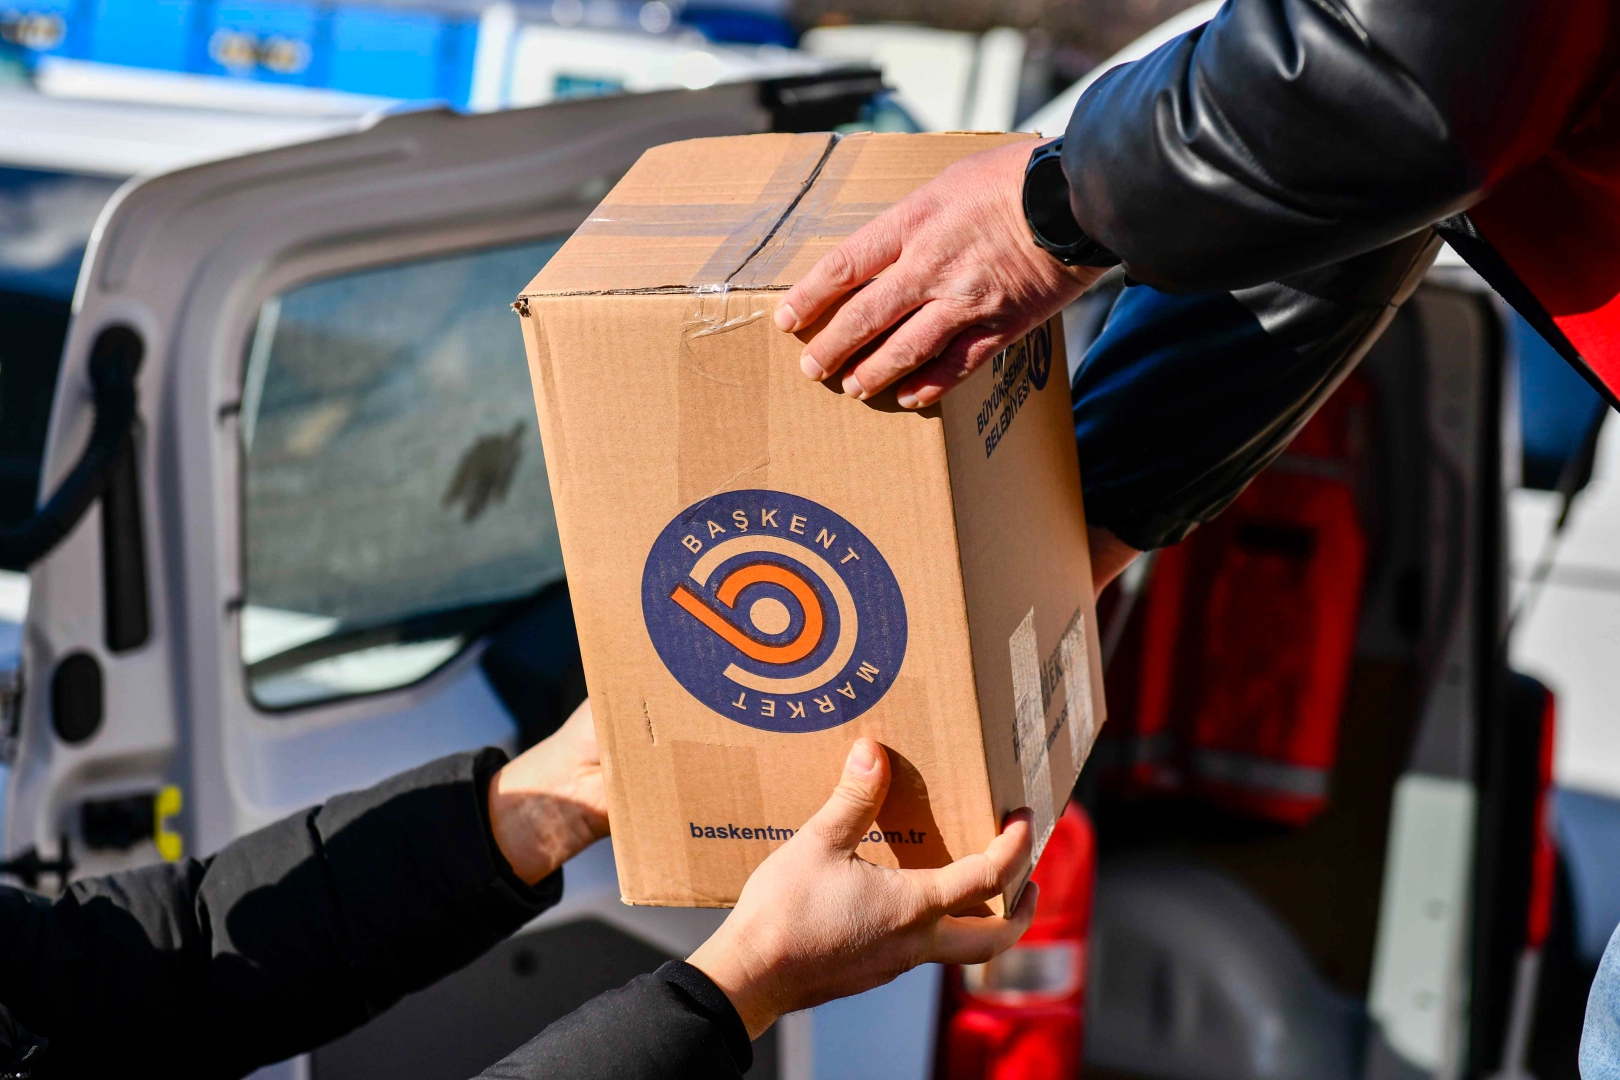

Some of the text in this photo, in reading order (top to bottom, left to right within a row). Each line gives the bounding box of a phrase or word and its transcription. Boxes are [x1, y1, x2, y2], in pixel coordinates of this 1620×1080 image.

[977, 346, 1027, 436] BÜYÜKŞEHİR
[985, 370, 1030, 459] BELEDİYESİ
[681, 508, 860, 565] BAŞKENT
[732, 661, 880, 719] MARKET
